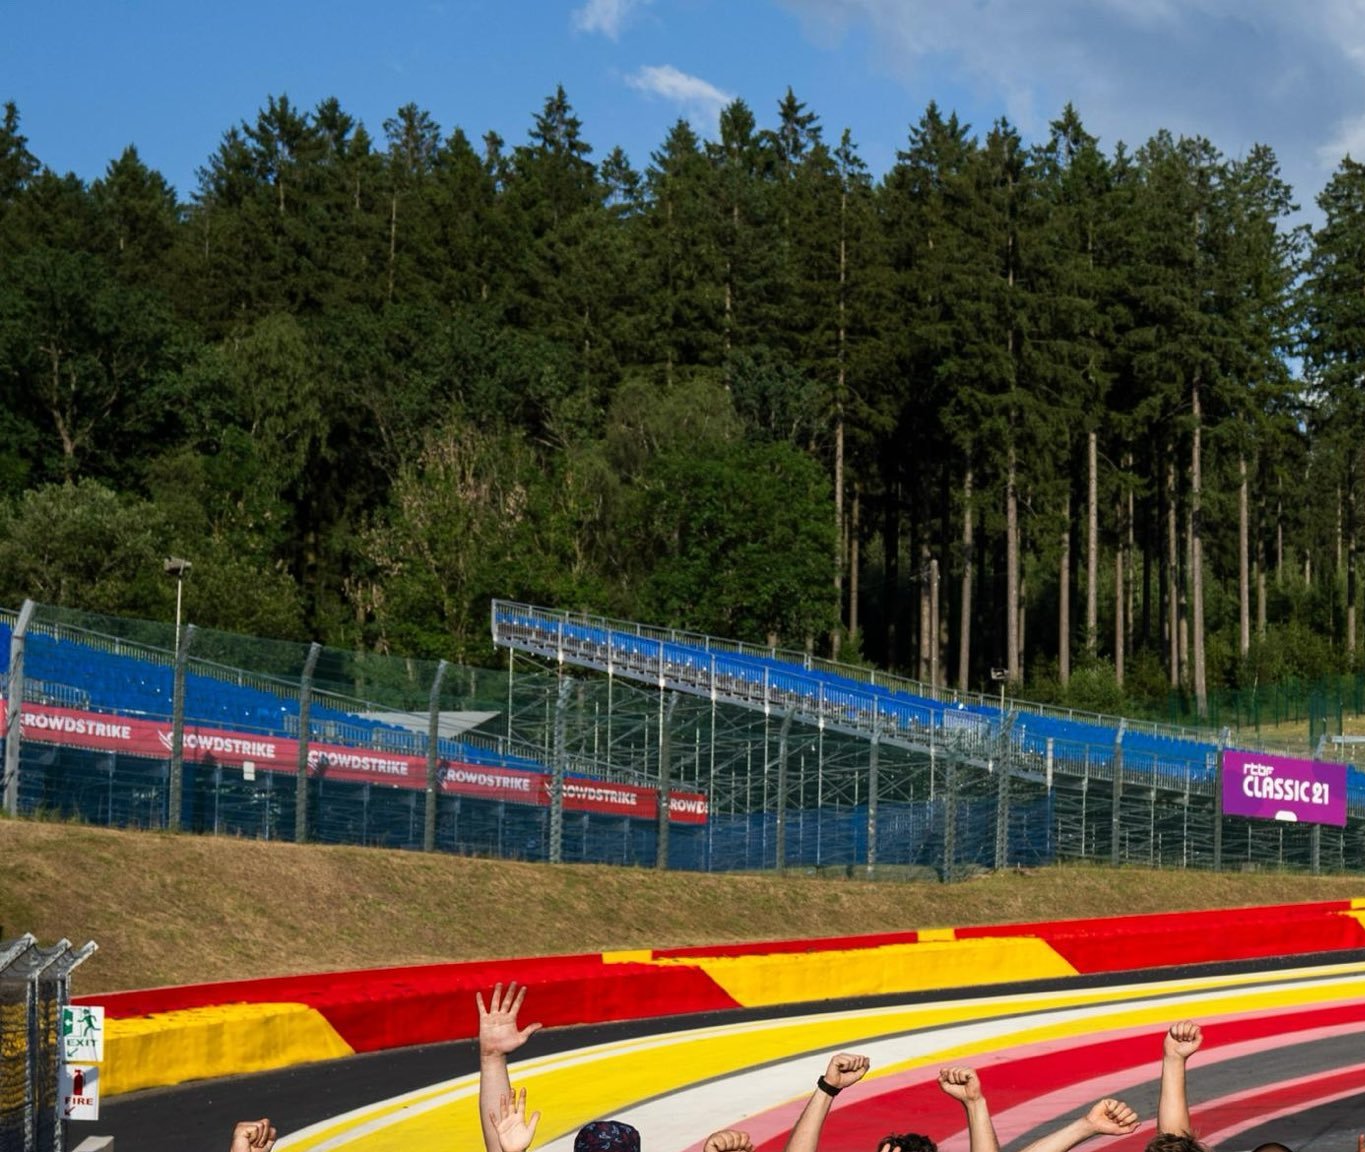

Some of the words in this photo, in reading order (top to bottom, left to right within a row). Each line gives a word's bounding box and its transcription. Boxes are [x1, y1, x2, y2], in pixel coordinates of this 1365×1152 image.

[1243, 763, 1274, 776] rtbf
[1243, 776, 1310, 802] CLASSIC
[1311, 784, 1329, 805] 21
[67, 1038, 98, 1048] EXIT
[65, 1097, 93, 1106] FIRE
